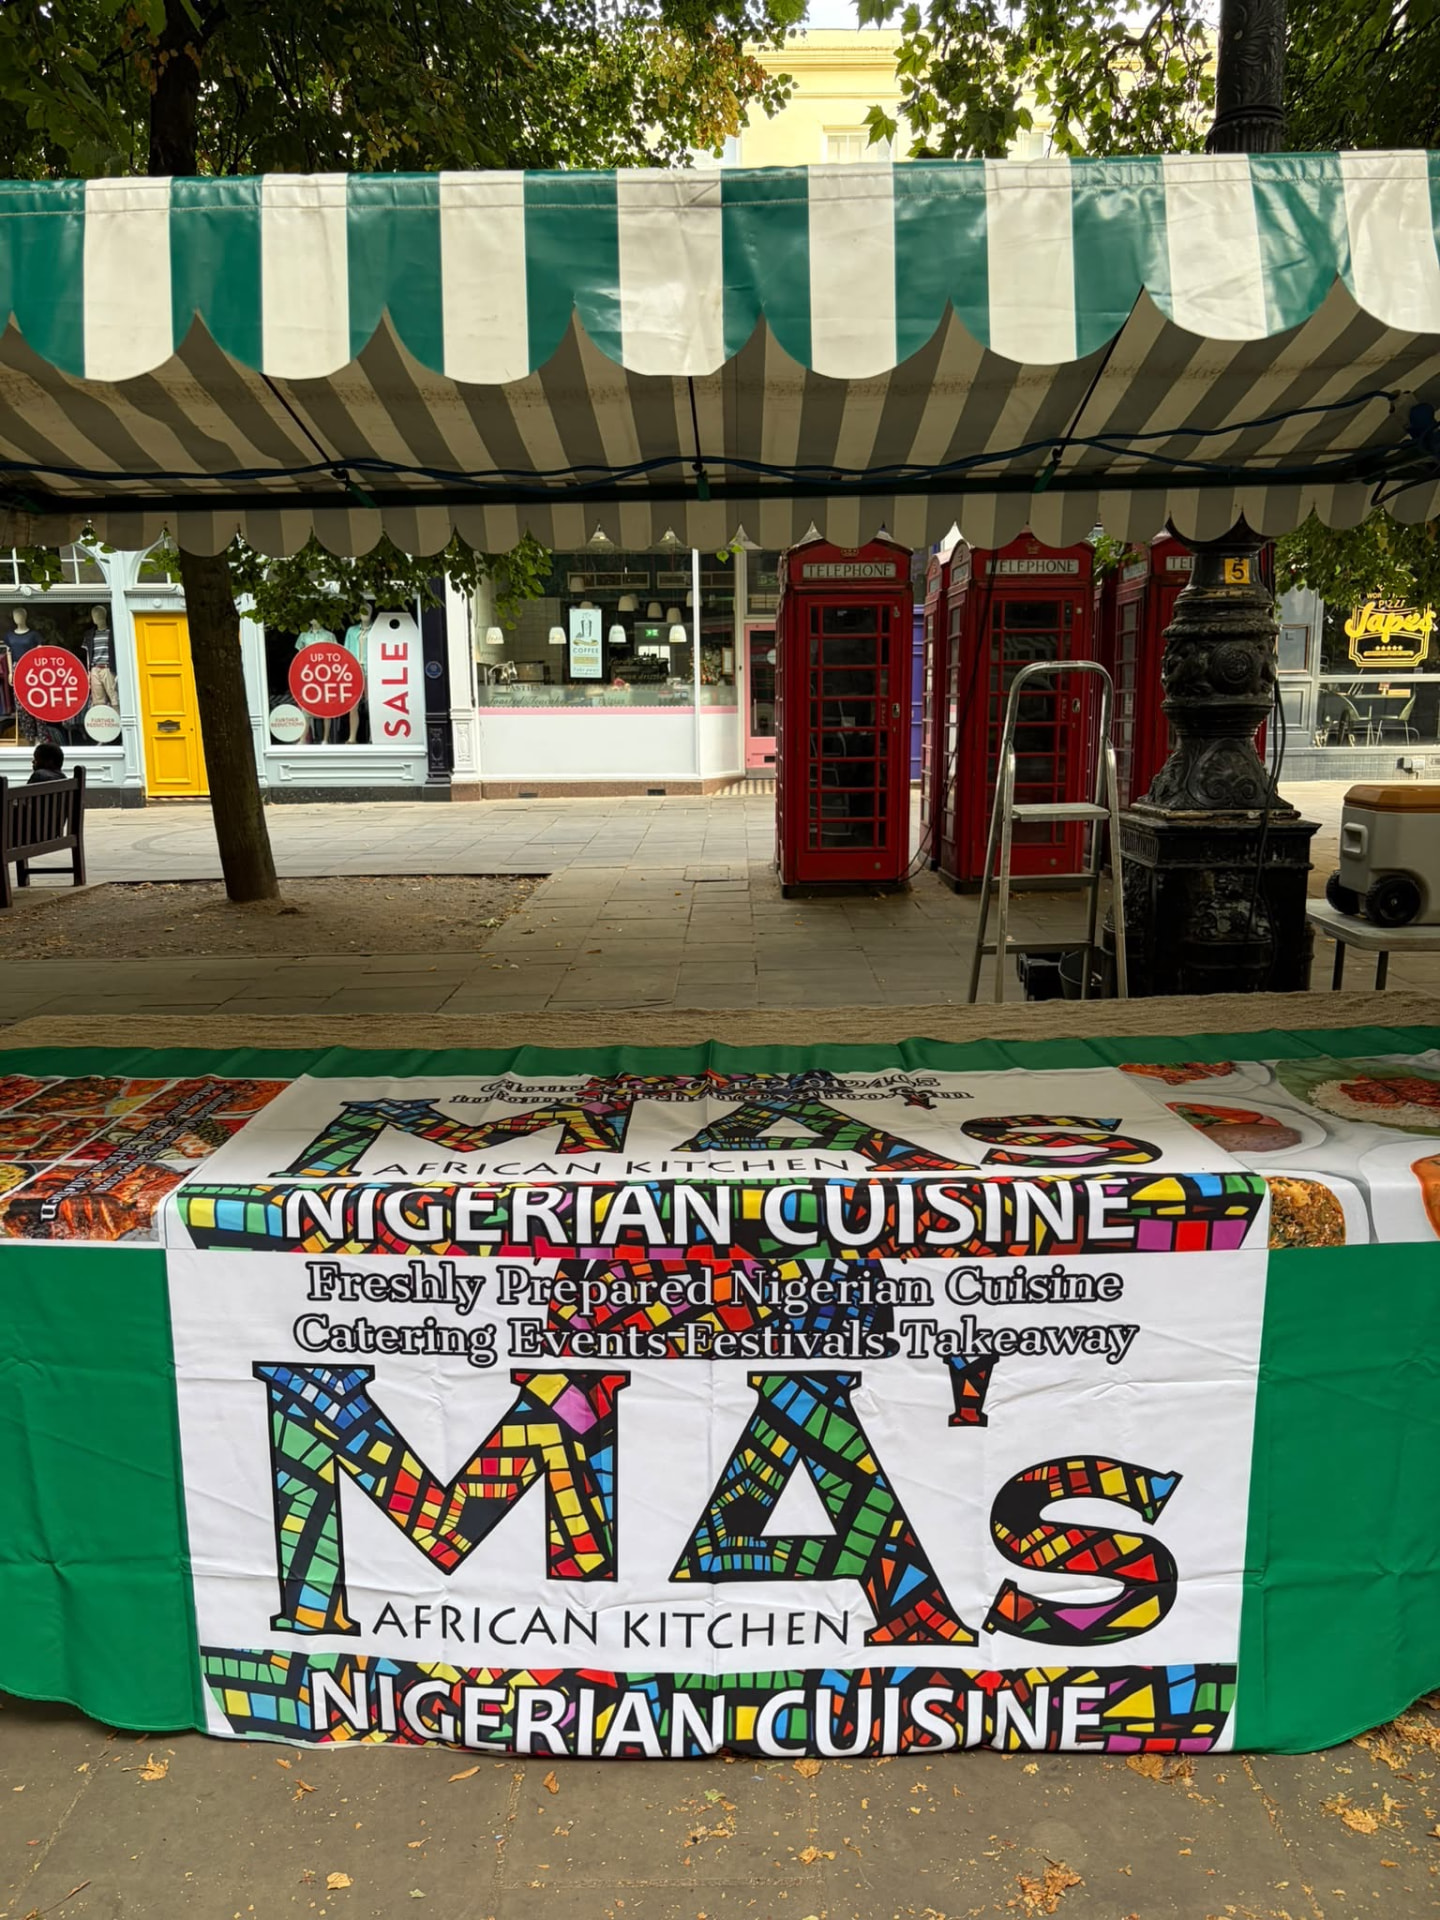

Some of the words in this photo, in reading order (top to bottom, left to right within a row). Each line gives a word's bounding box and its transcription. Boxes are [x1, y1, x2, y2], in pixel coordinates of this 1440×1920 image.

[806, 564, 891, 577] TELEPHONE
[1231, 562, 1245, 580] 5
[1344, 601, 1437, 643] Japes
[34, 657, 48, 667] UP
[50, 657, 65, 667] TO
[310, 654, 324, 663] UP
[327, 653, 341, 662] TO
[25, 667, 78, 686] 60%
[300, 664, 353, 682] 60%
[27, 687, 78, 708] OFF
[301, 683, 353, 704] OFF
[381, 642, 411, 738] SALE
[373, 1160, 611, 1176] AFRICAN
[626, 1158, 849, 1174] KITCHEN
[284, 1184, 731, 1246] NIGERIAN
[763, 1178, 1136, 1246] CUISINE
[306, 1260, 486, 1314] Freshly
[497, 1260, 715, 1316] Prepared
[730, 1266, 934, 1316] Nigerian
[945, 1264, 1124, 1306] Cuisine
[294, 1314, 498, 1367] Catering
[509, 1318, 668, 1360] Events
[682, 1318, 887, 1360] Festivals
[900, 1314, 1140, 1364] Takeaway
[372, 1601, 599, 1646] AFRICAN
[623, 1610, 849, 1649] KITCHEN
[309, 1669, 726, 1757] NIGERIAN
[753, 1686, 1107, 1758] CUISINE
